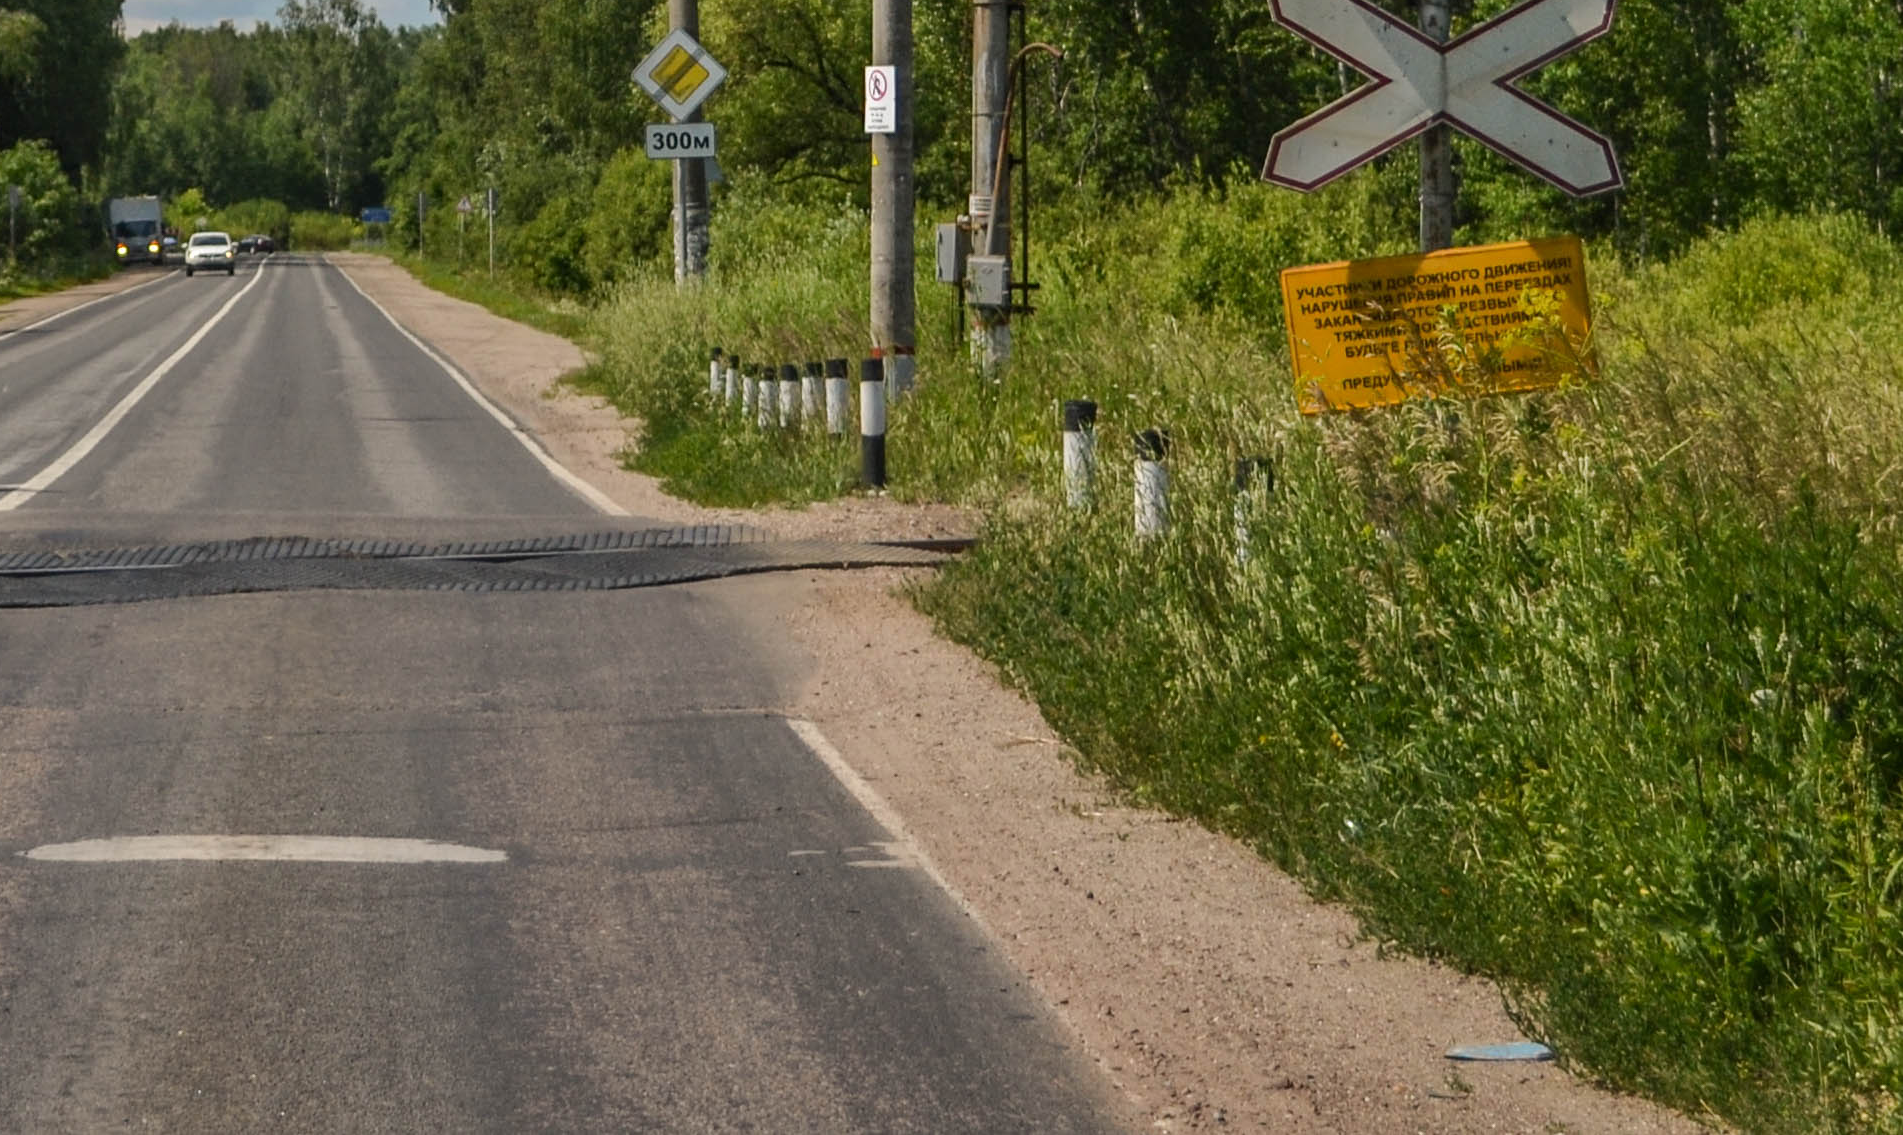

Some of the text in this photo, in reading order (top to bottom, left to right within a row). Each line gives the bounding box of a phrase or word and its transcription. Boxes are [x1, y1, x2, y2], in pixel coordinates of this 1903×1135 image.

[1386, 268, 1480, 290] ДОРОЖНОГО
[1484, 257, 1572, 279] ДВИЖЕНИЯ!
[1301, 294, 1393, 315] НАРУШЕИЯ
[1460, 283, 1481, 297] НА
[1314, 303, 1444, 330] ЗАКАНИВЮТСЯ
[1410, 310, 1544, 334] ОСЕДСТВИЯМ
